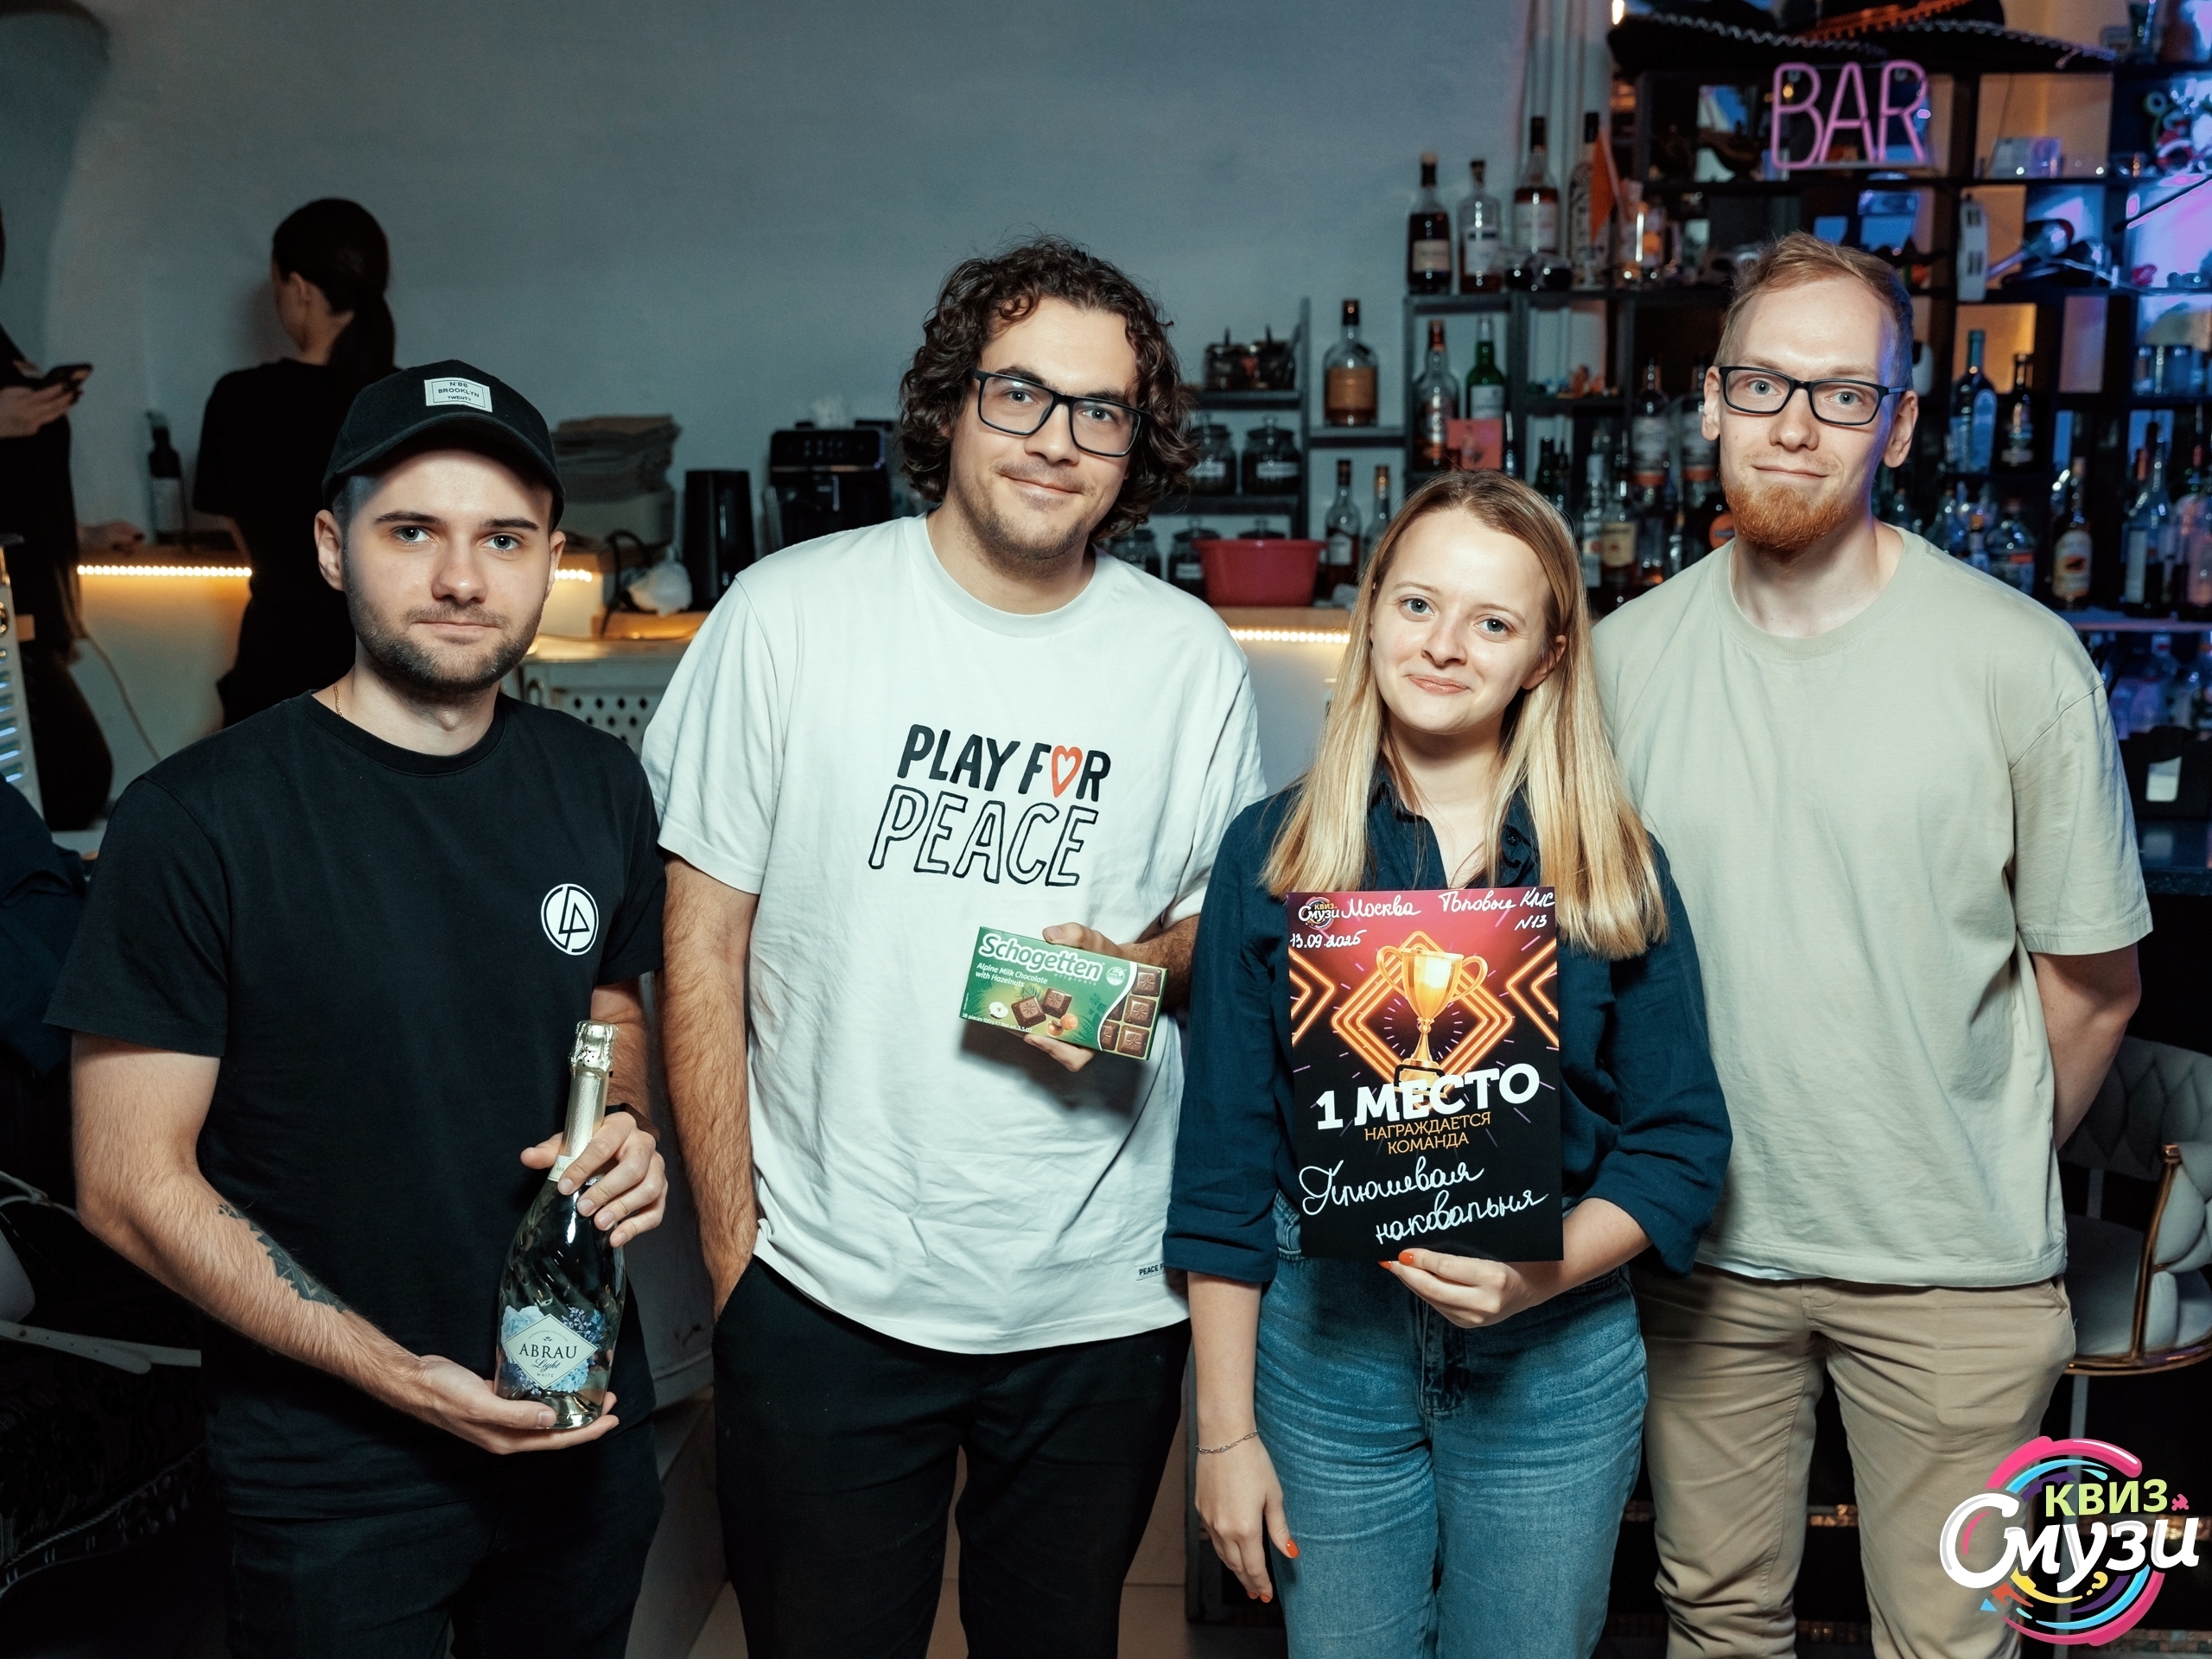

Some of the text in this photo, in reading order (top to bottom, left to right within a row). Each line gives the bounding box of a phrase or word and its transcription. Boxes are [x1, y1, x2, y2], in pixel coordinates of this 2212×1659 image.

[1770, 59, 1929, 170] BAR
[438, 388, 480, 397] BROOKLYN
[897, 724, 1020, 791] PLAY
[868, 784, 1099, 887] PEACE
[1298, 905, 1339, 922] Смузи
[1341, 894, 1421, 918] Москва
[978, 932, 1103, 982] Schogetten
[976, 962, 1048, 984] Alpine Milk Chocolate
[976, 970, 1025, 988] with Hazelnuts
[1053, 973, 1096, 986] originals
[1316, 1063, 1540, 1130] 1 МЕСТО
[1363, 1111, 1491, 1141] НАГРАЖДАЕТСЯ
[1387, 1132, 1469, 1154] КОМАНДА
[1298, 1155, 1485, 1216] Плюшевая
[1375, 1189, 1549, 1245] наковальня
[1139, 1264, 1159, 1275] PEACE
[518, 1343, 578, 1359] ABRAU
[531, 1357, 562, 1373] Light
